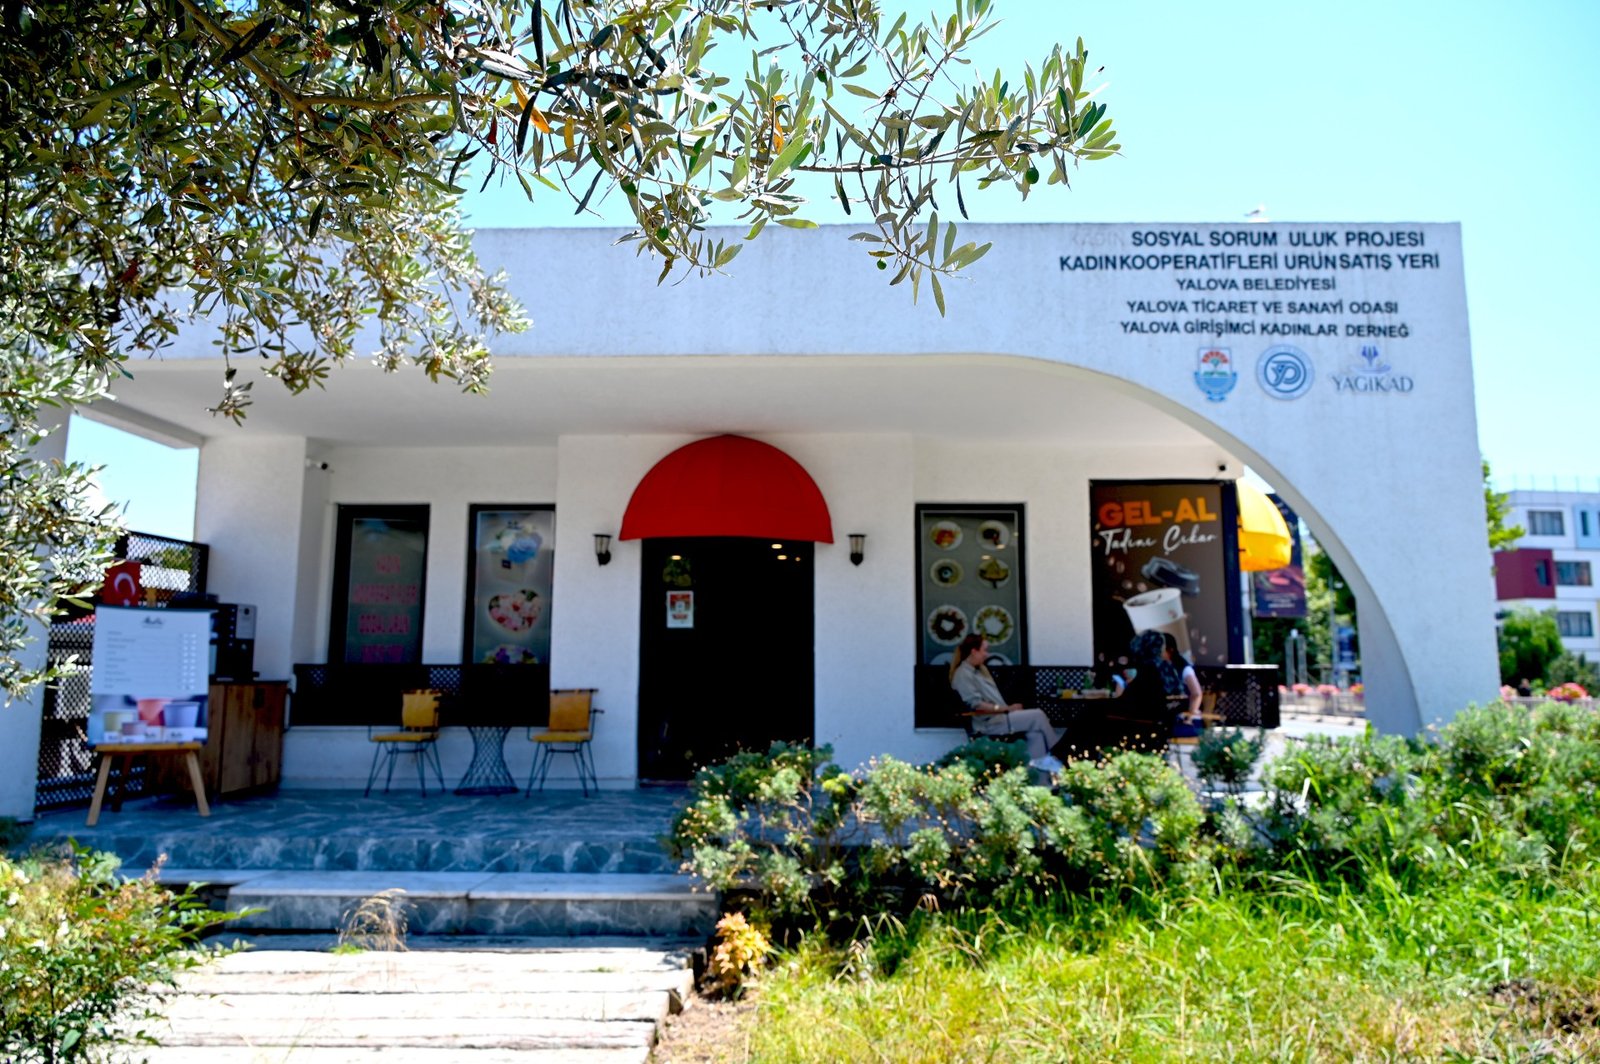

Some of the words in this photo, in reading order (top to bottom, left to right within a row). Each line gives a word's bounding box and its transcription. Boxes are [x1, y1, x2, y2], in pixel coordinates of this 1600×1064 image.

[1131, 230, 1205, 248] SOSYAL
[1208, 230, 1278, 248] SORUM
[1288, 230, 1339, 248] ULUK
[1059, 253, 1118, 272] KADIN
[1338, 252, 1393, 272] SATIŞ
[1176, 277, 1240, 291] YALOVA
[1126, 299, 1189, 314] YALOVA
[1192, 297, 1258, 314] TİCARET
[1262, 300, 1283, 314] VE
[1348, 300, 1399, 315] ODASI
[1120, 320, 1181, 335] YALOVA
[1260, 321, 1338, 336] KADINLAR
[1099, 497, 1217, 527] GEL-AL
